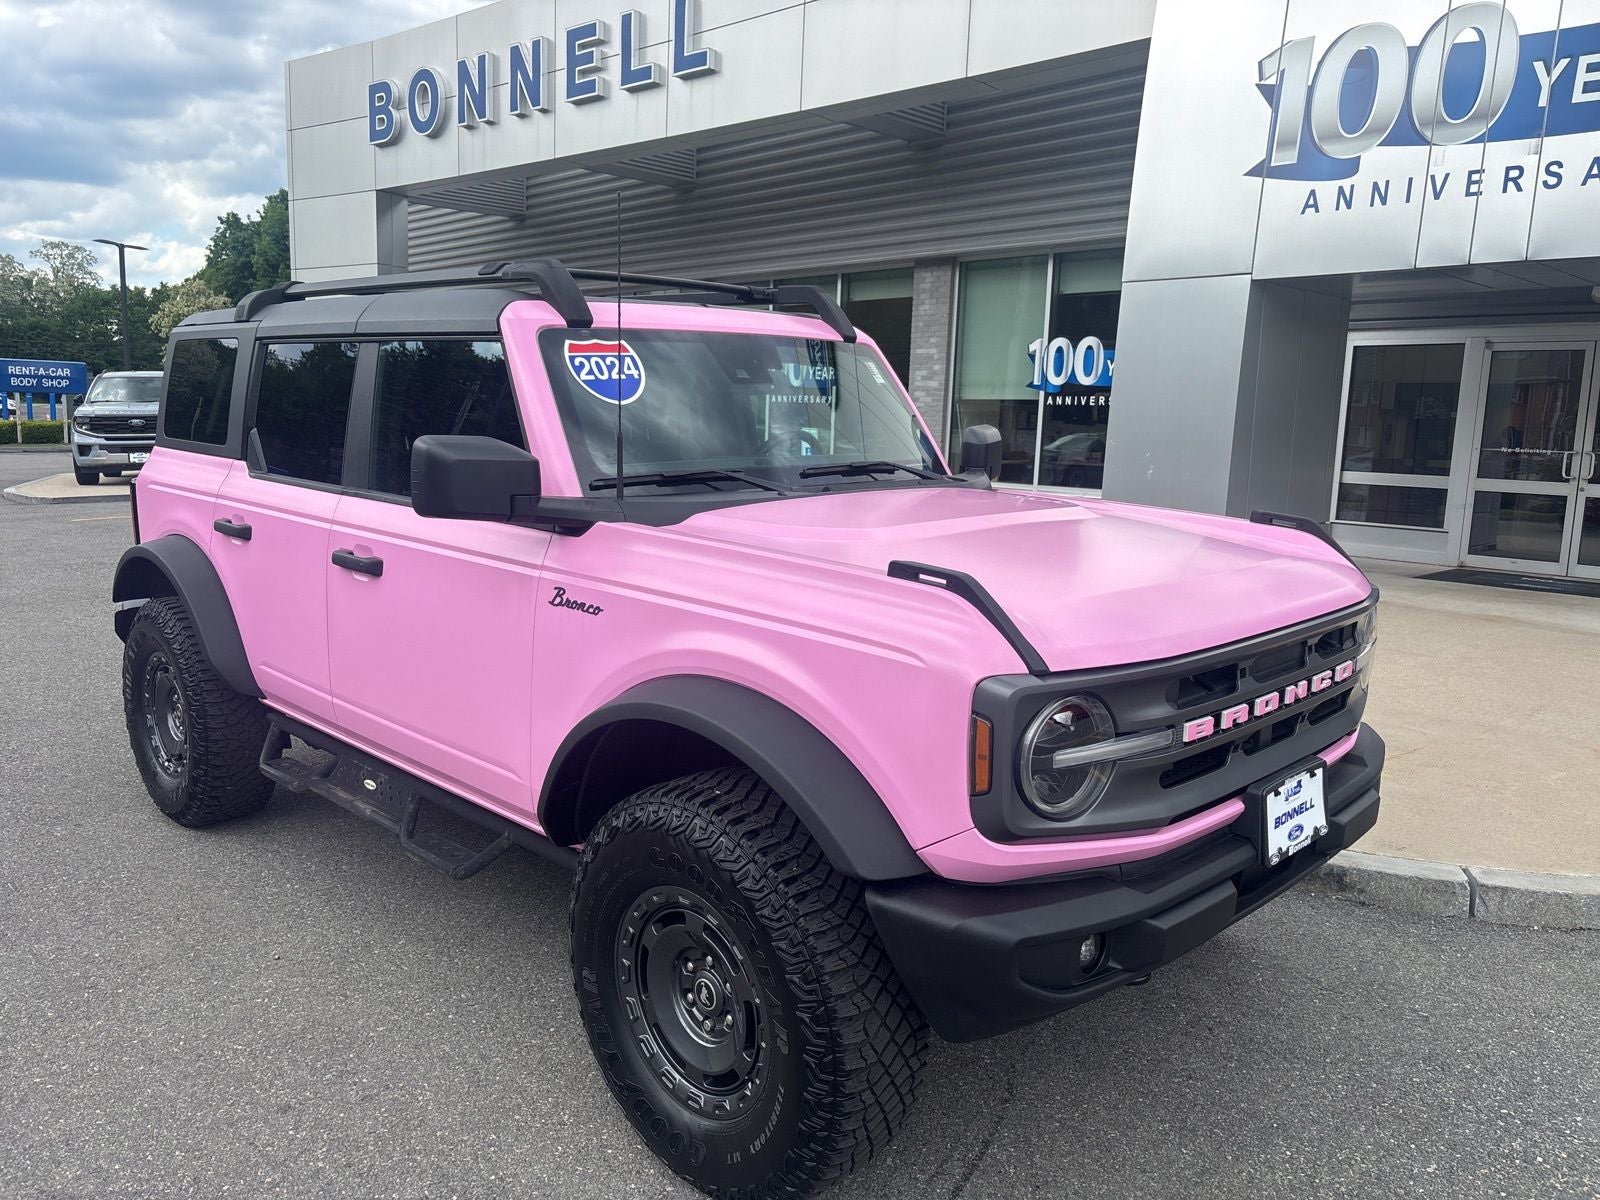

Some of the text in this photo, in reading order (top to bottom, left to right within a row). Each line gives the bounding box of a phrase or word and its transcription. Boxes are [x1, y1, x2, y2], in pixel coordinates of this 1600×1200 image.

[368, 0, 717, 146] BONNELL
[1258, 1, 1520, 167] 100
[8, 365, 71, 377] RENT-A-CAR
[574, 356, 640, 381] 2024
[1028, 336, 1104, 386] 100
[10, 377, 70, 388] BODY SHOP
[771, 394, 833, 406] ANNIVERSARY
[1046, 395, 1111, 406] ANNIVER
[548, 586, 604, 616] Bronco
[1183, 660, 1354, 742] BRONCO
[1274, 798, 1315, 830] BONNELL
[1288, 834, 1312, 856] Bonnell
